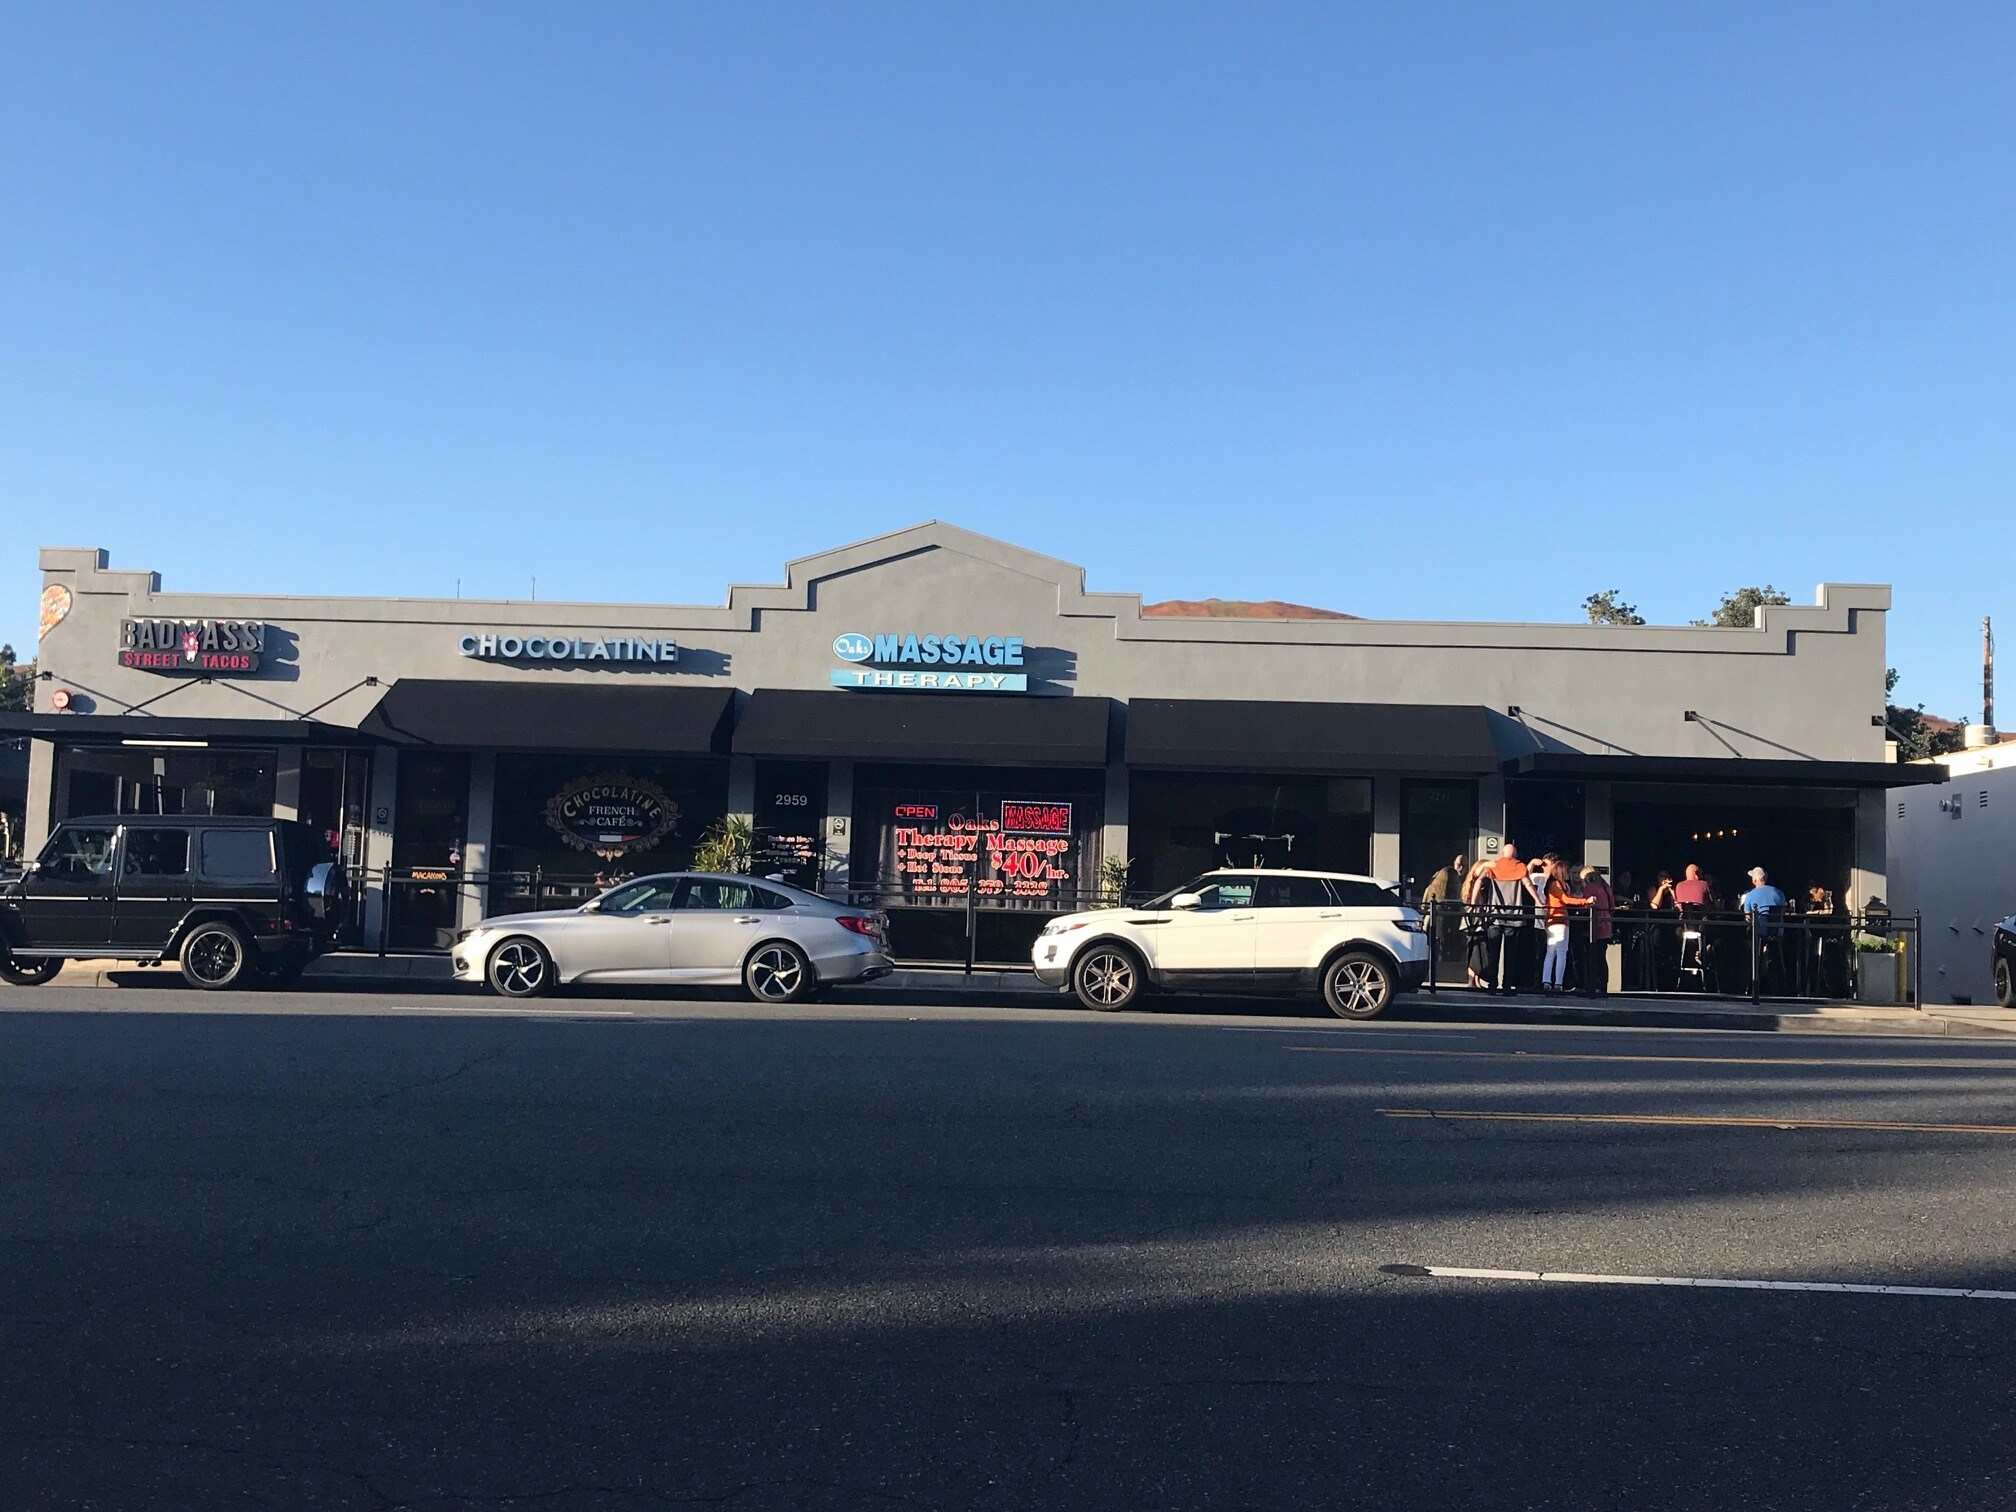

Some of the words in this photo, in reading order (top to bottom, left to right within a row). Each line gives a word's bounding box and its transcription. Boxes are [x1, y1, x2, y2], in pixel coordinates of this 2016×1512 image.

[120, 619, 176, 648] BAD
[202, 620, 259, 650] ASS
[458, 633, 677, 662] CHOCOLATINE
[835, 638, 868, 653] Oaks
[874, 633, 1024, 666] MASSAGE
[124, 653, 180, 667] STREET
[202, 655, 250, 668] TACOS
[852, 671, 1007, 689] THERAPY
[563, 786, 661, 818] CHOCOLATINE
[775, 794, 808, 806] 2959
[589, 806, 635, 816] FRENCH
[895, 806, 935, 818] OPEN
[1005, 805, 1069, 831] MASSAGE
[596, 816, 627, 827] CAFÉ
[948, 813, 999, 831] Oaks
[896, 828, 979, 850] Therapy
[986, 833, 1068, 856] Massage
[907, 848, 937, 862] Deep
[941, 849, 978, 862] Tissue
[907, 861, 928, 873] Hot
[932, 862, 964, 874] Stone
